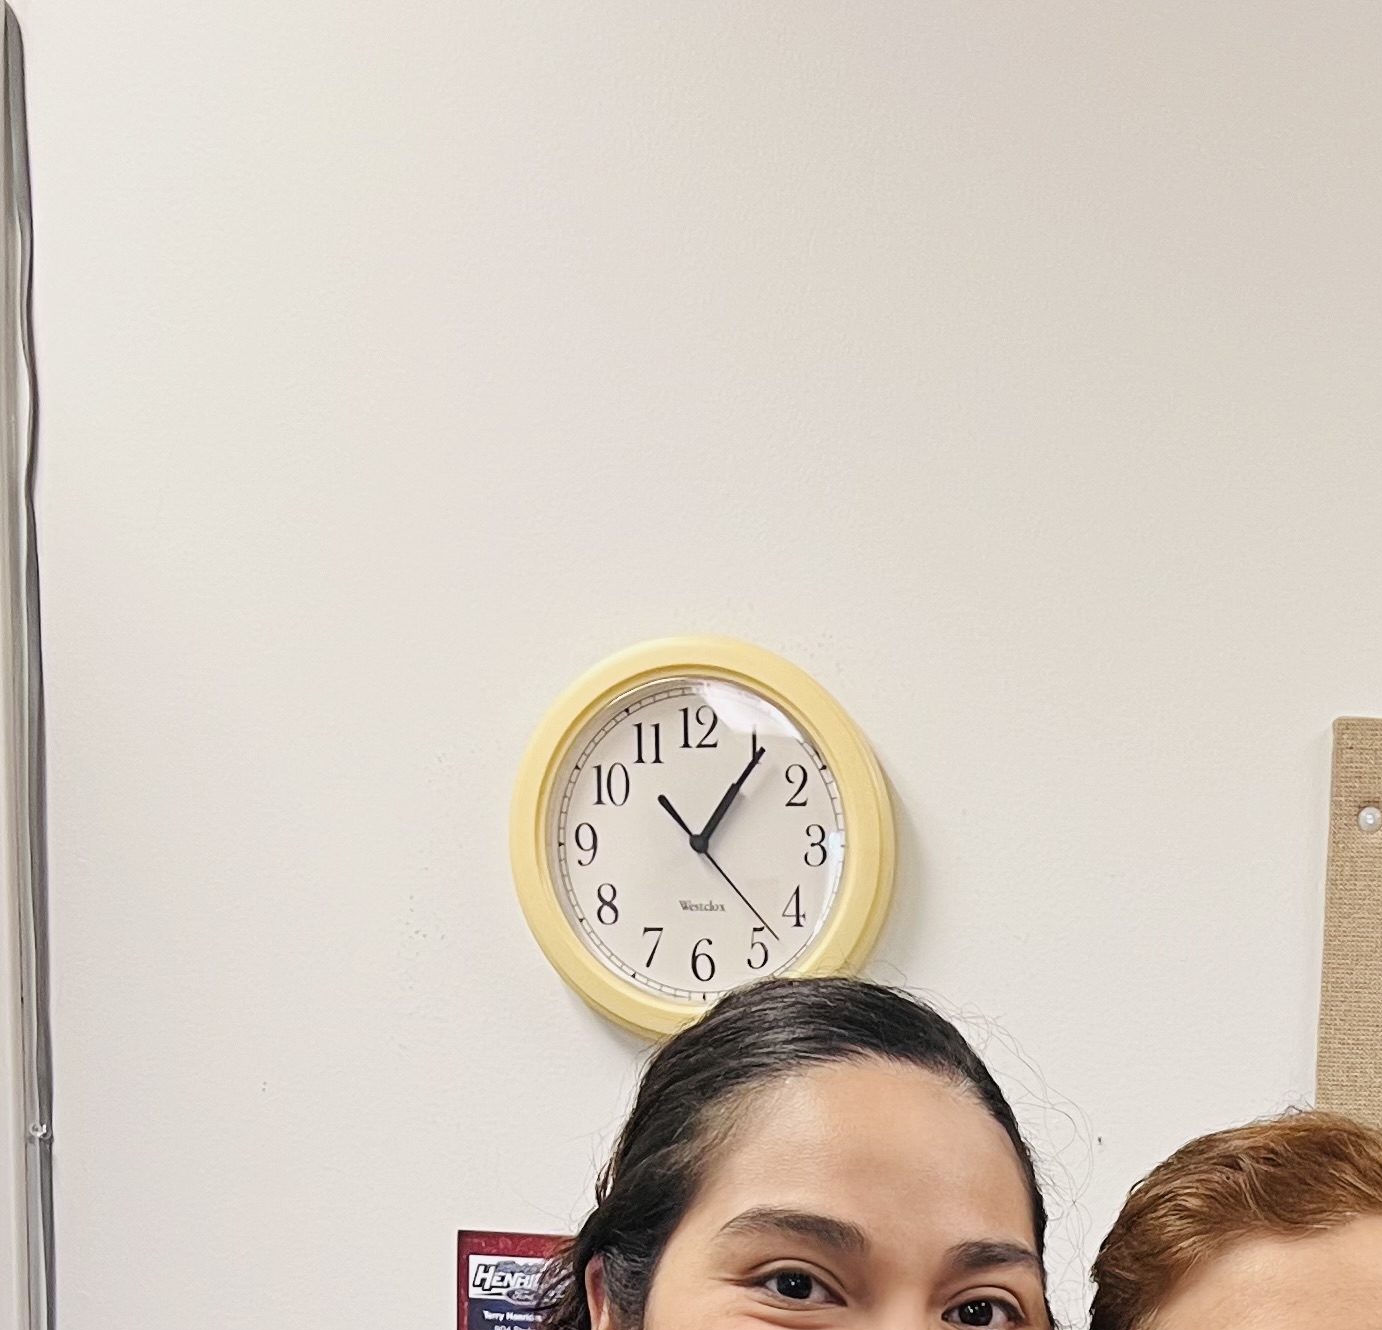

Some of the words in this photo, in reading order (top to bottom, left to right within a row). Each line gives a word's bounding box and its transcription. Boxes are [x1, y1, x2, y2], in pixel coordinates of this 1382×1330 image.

[633, 722, 664, 764] 11
[679, 705, 719, 749] 12
[593, 762, 631, 807] 10
[785, 763, 809, 808] 2
[574, 822, 598, 866] 9
[804, 824, 828, 867] 3
[597, 883, 619, 925] 8
[782, 884, 806, 928] 4
[642, 927, 664, 968] 7
[690, 938, 716, 982] 6
[746, 926, 769, 970] 5
[472, 1263, 543, 1292] HENRI
